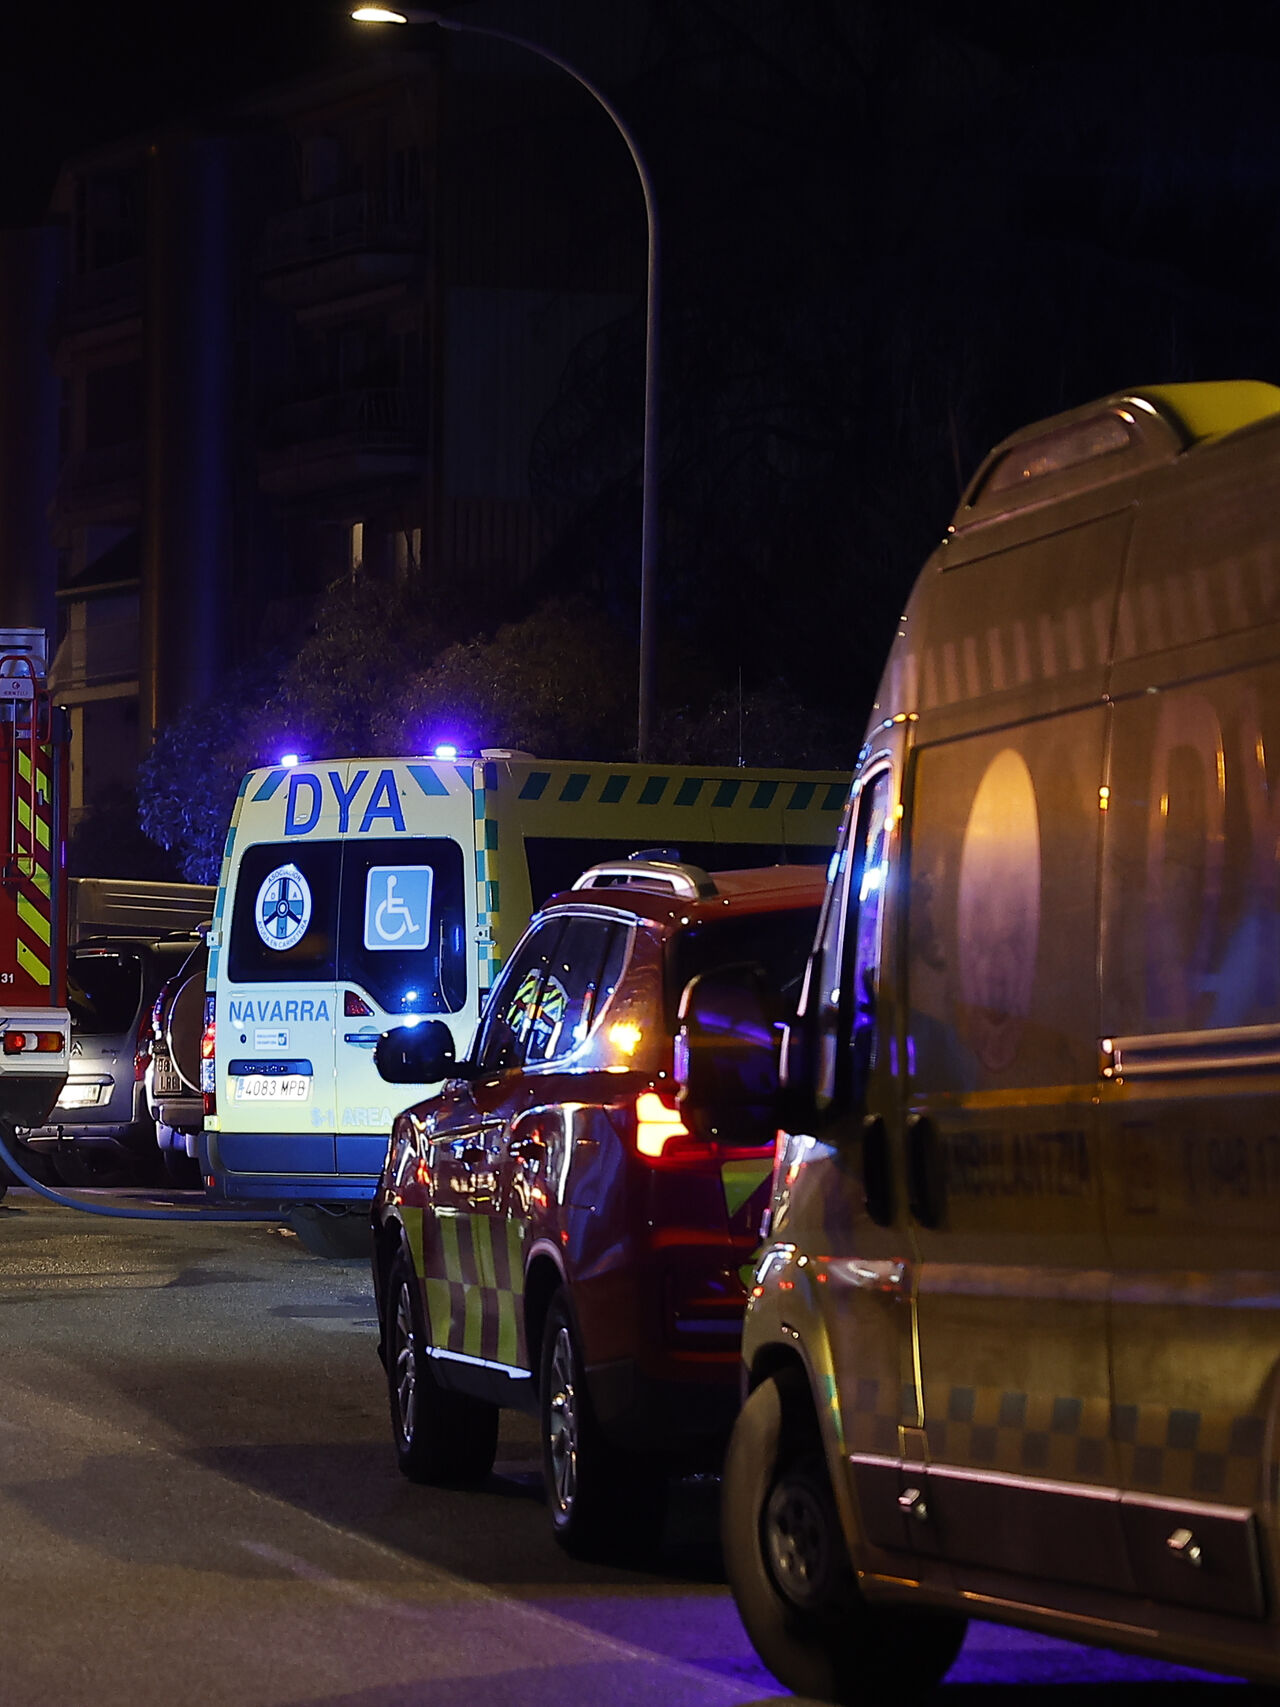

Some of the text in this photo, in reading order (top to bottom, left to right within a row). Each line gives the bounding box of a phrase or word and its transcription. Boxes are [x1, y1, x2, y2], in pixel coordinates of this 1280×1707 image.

[284, 769, 407, 836] DYA
[229, 1000, 330, 1022] NAVARRA
[245, 1080, 306, 1096] 4083 MPB
[342, 1106, 394, 1127] AREA
